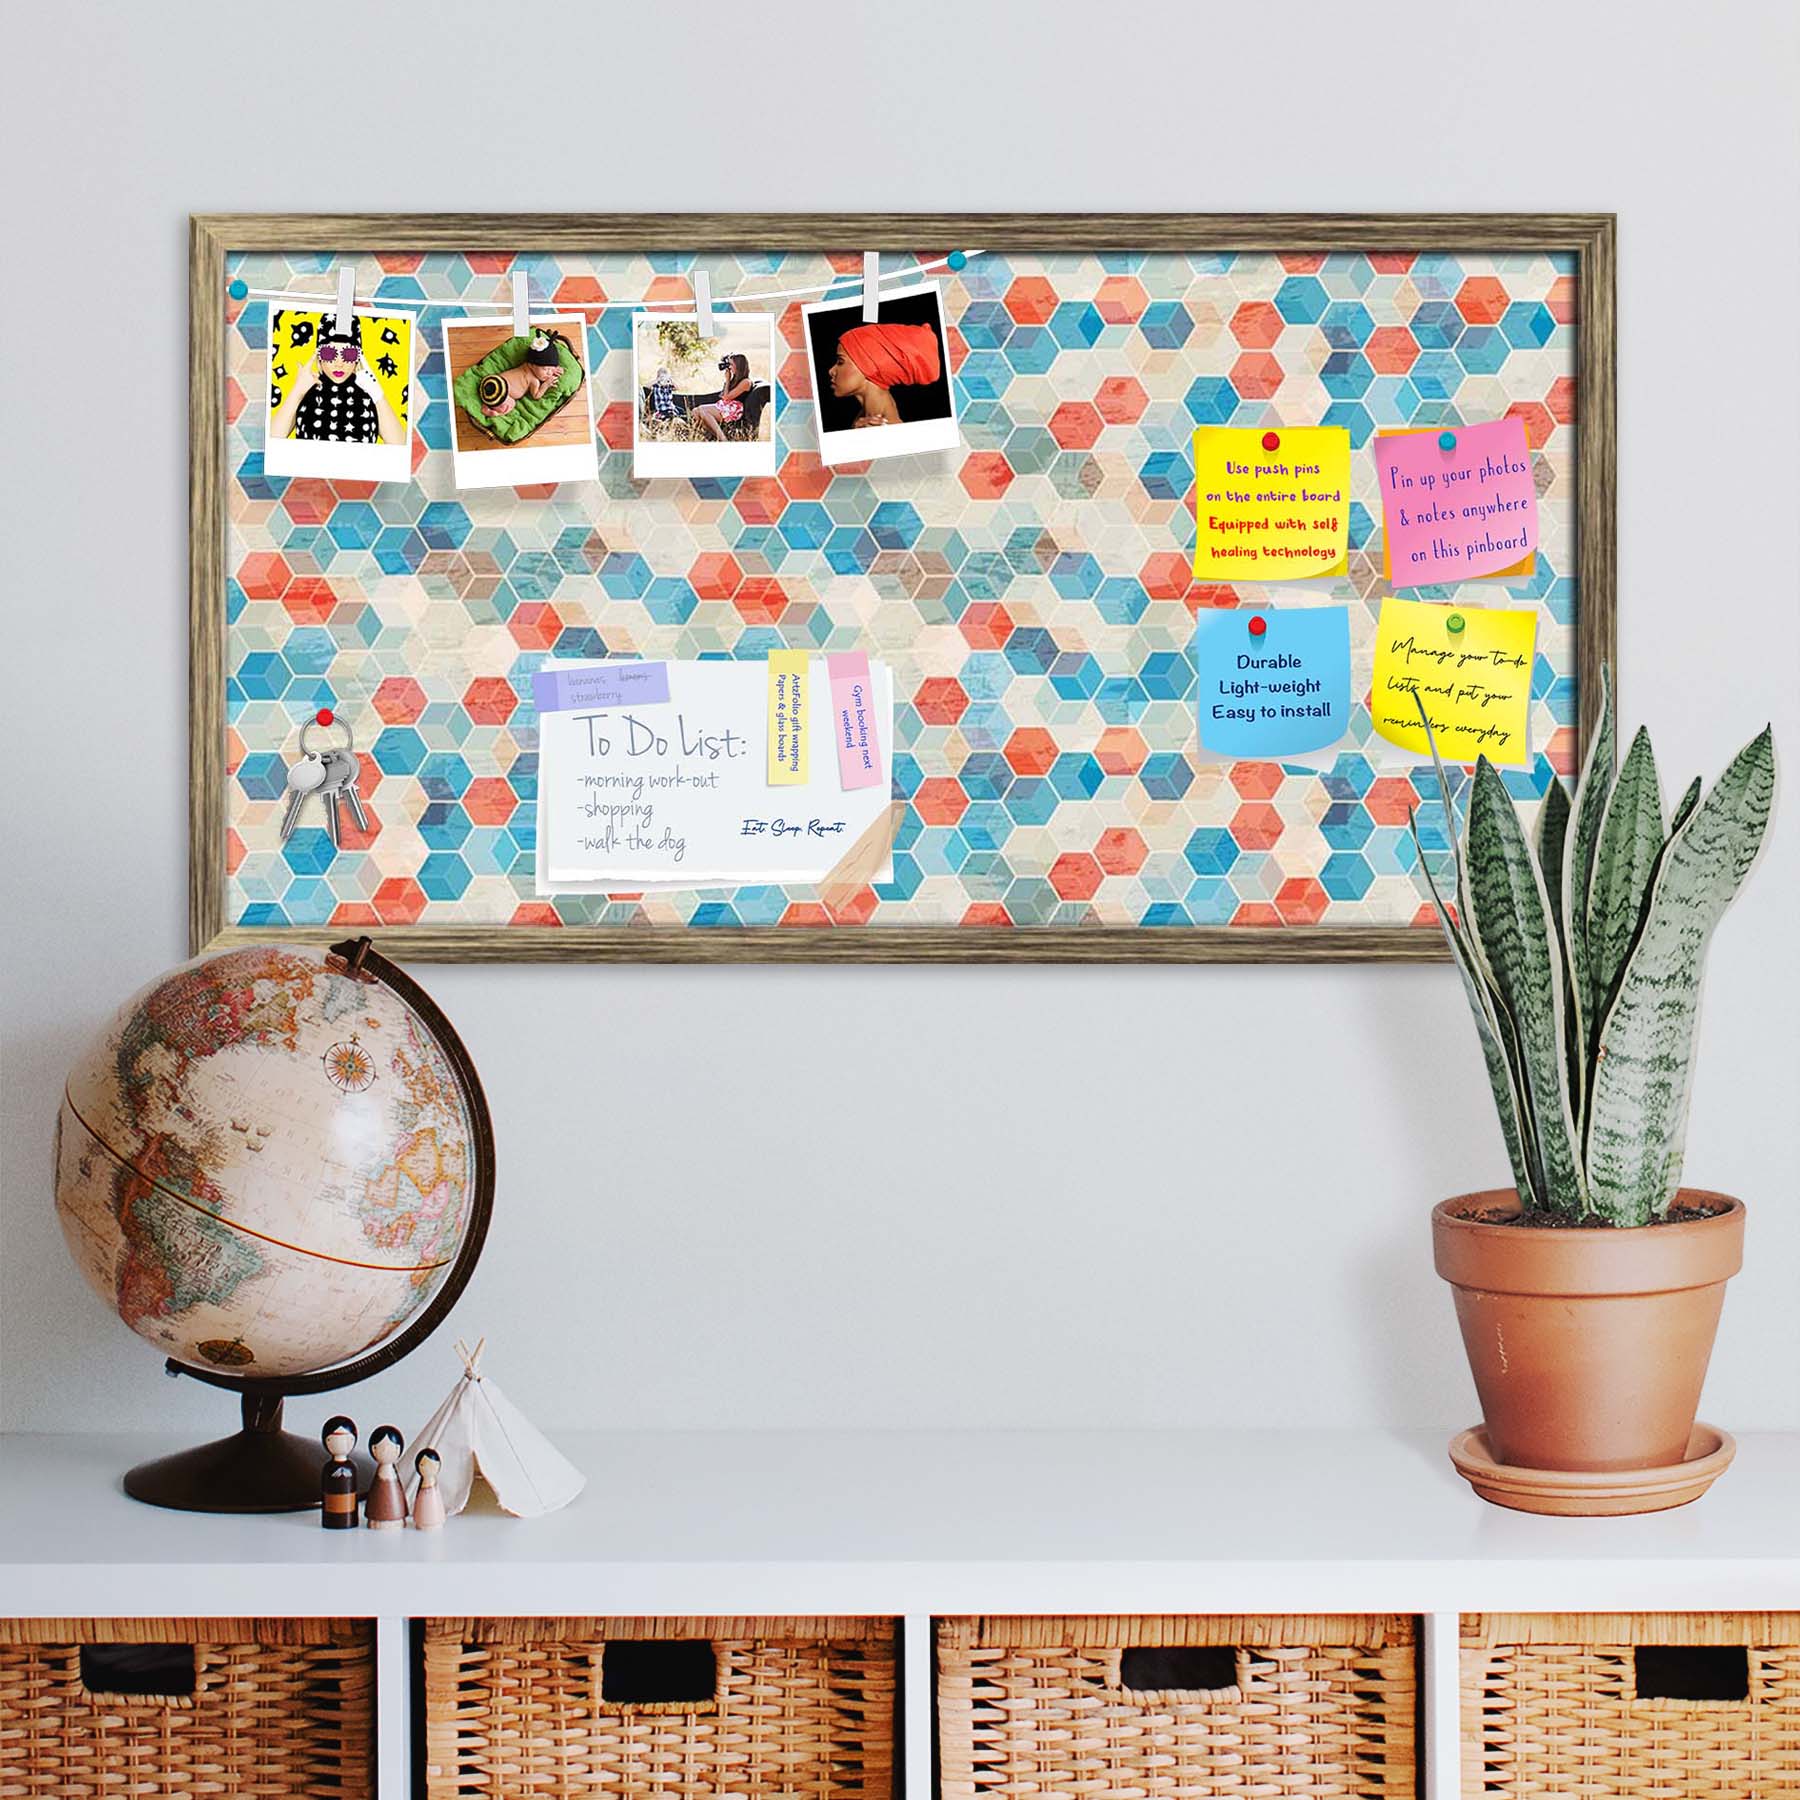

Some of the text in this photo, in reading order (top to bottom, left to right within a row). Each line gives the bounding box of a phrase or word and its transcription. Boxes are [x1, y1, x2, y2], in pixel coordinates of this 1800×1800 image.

[1226, 461, 1320, 479] Use push pins
[1391, 454, 1526, 490] Pin up your photos
[1206, 489, 1341, 503] on the entire board
[1400, 493, 1528, 526] & notes anywhere
[1209, 516, 1338, 534] Equipped with self
[1211, 545, 1336, 560] healing technology
[1411, 527, 1527, 562] on this pinboard
[1237, 654, 1302, 669] Durable
[1391, 636, 1455, 664] Manage
[1456, 651, 1488, 668] your
[1219, 678, 1321, 698] Light-weight
[1424, 683, 1454, 698] and
[1455, 684, 1485, 704] put
[1481, 693, 1512, 707] your
[776, 674, 787, 762] Papers & glass boards
[1212, 702, 1331, 722] Easy to install
[789, 716, 802, 733] gift
[842, 709, 856, 749] weekend
[852, 685, 873, 769] Gym booking next
[1455, 724, 1511, 746] everyday
[572, 714, 746, 760] To Do List:
[789, 734, 800, 772] wrapping
[649, 764, 720, 788] work-out
[626, 824, 654, 850] the
[657, 826, 687, 862] dog
